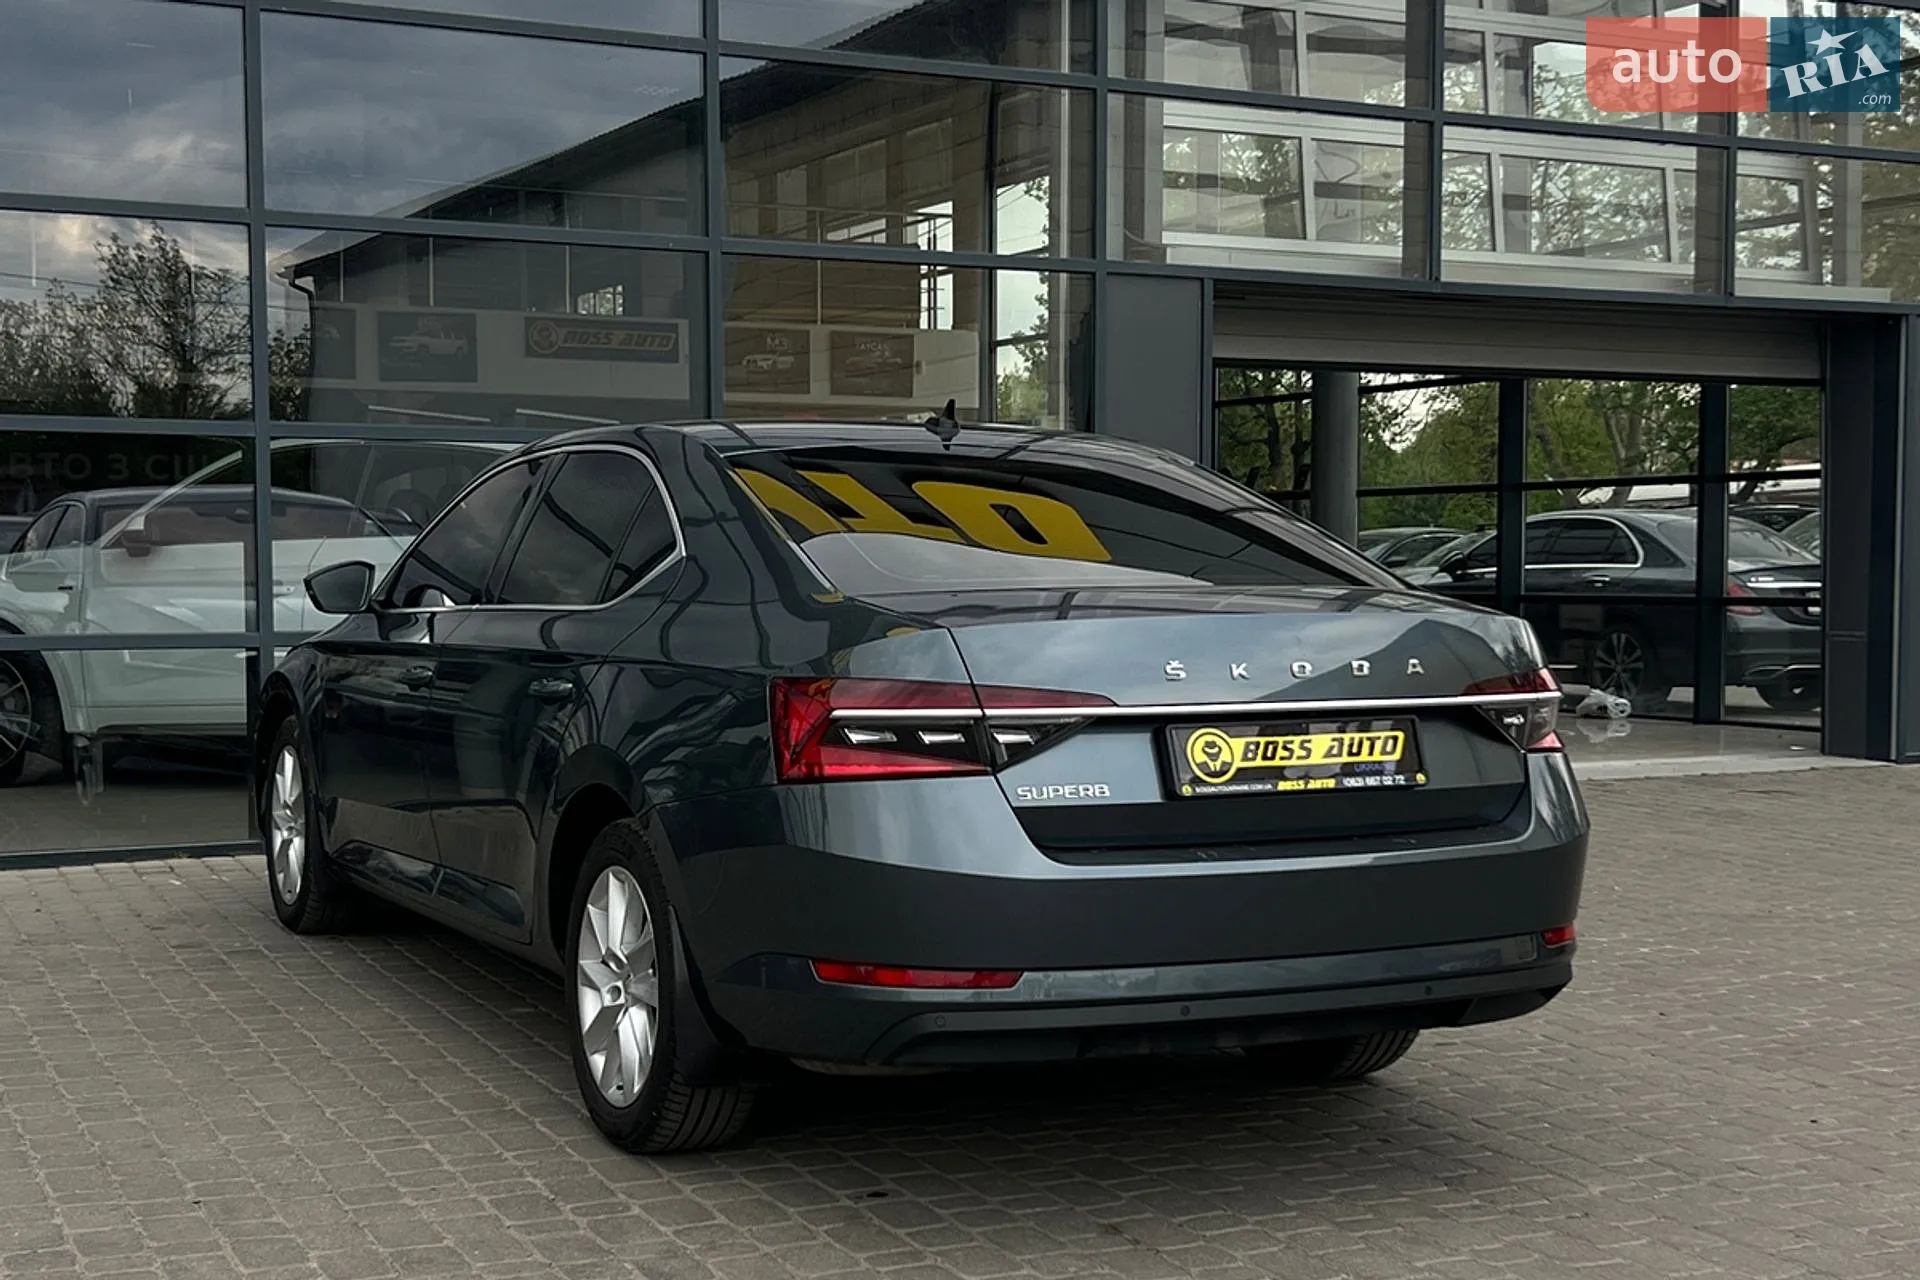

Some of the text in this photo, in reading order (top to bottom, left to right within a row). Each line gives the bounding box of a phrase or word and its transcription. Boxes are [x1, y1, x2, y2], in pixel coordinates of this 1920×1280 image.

[0, 452, 92, 480] ВТО
[1241, 735, 1399, 762] BOSS AUTO
[1016, 783, 1111, 800] SUPERB
